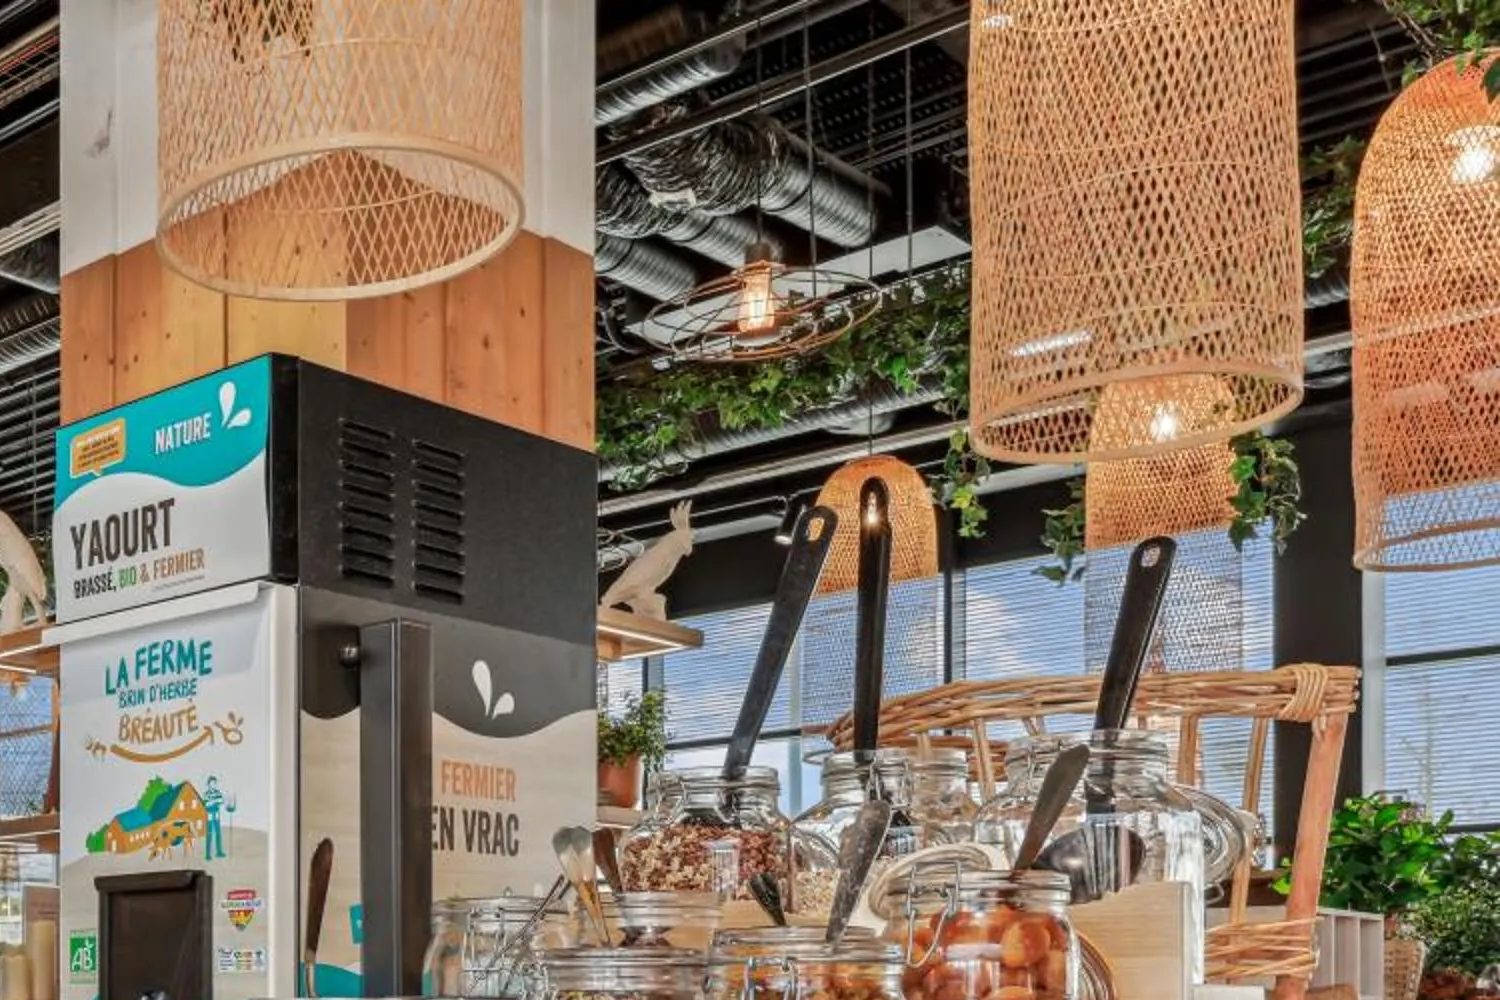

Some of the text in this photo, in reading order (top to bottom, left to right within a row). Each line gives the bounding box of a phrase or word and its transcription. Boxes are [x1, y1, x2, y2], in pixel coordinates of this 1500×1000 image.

[155, 412, 212, 454] NATURE
[70, 498, 175, 570] YAOURT
[73, 565, 117, 599] BRASSÉ,
[118, 566, 137, 589] BIO
[140, 563, 151, 584] &
[153, 548, 205, 580] FERMIER
[105, 638, 213, 696] LA FERME
[119, 678, 198, 709] BRIN D'HERBE
[119, 698, 199, 745] BRÉAUTÉ
[441, 760, 516, 802] FERMIER
[462, 808, 520, 857] VRAC
